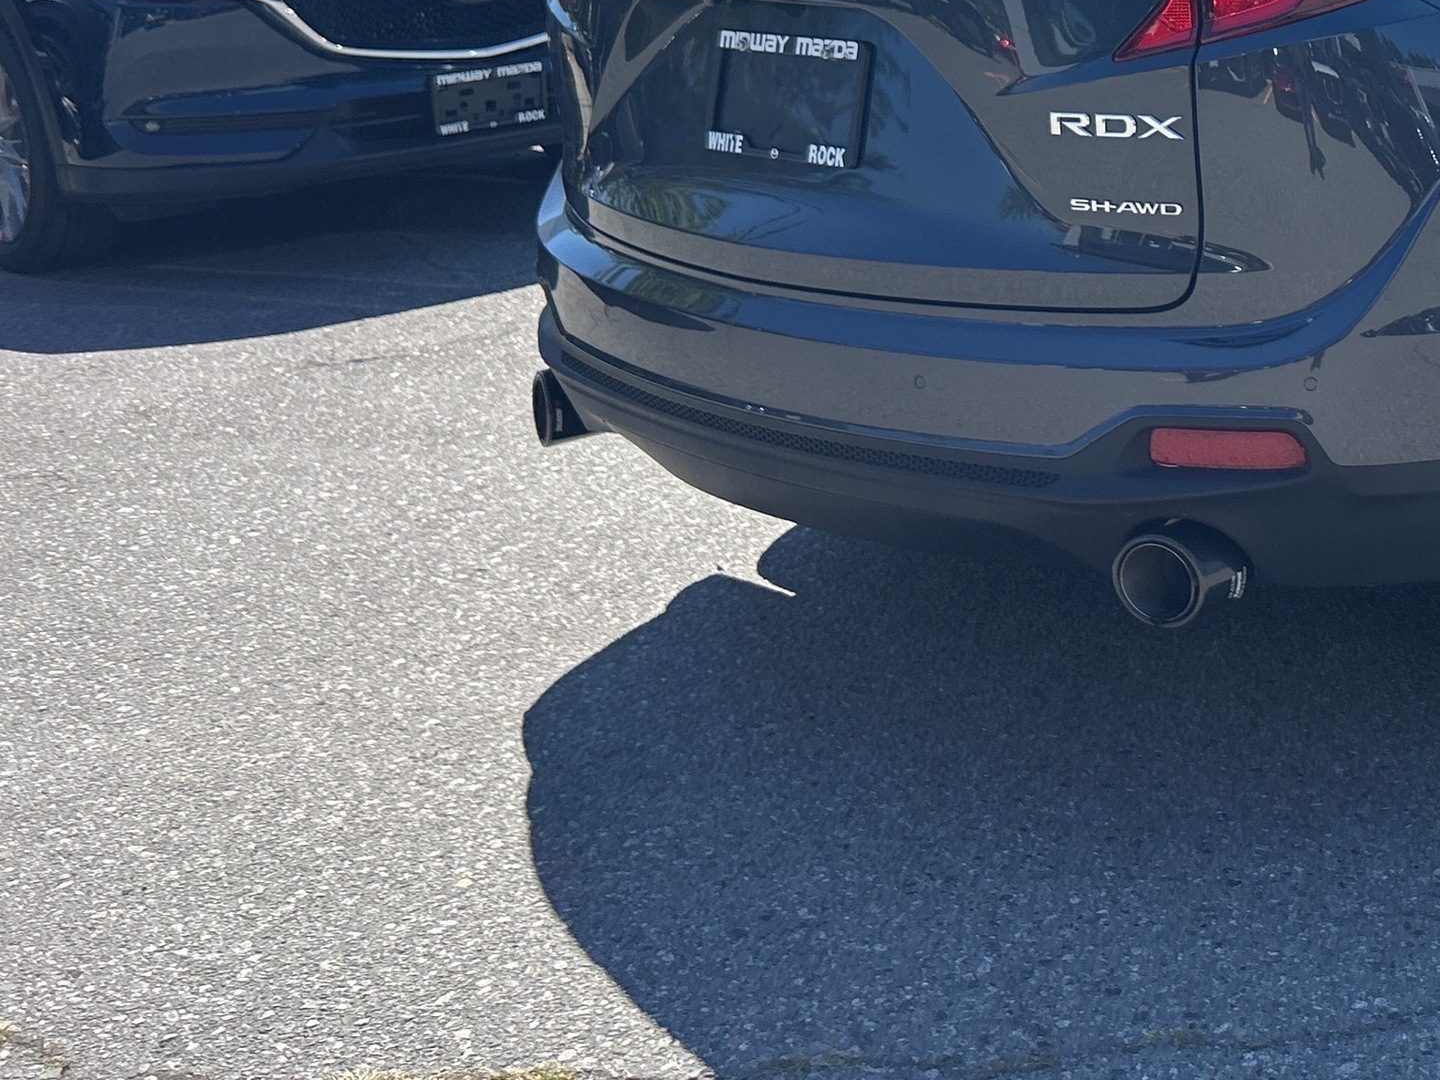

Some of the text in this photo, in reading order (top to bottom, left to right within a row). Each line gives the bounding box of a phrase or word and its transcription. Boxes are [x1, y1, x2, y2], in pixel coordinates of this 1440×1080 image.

[440, 108, 545, 136] WHITE ROCK
[1050, 111, 1185, 141] RDX
[708, 130, 846, 168] WHITE ROCK
[1070, 198, 1183, 216] SH-AWD
